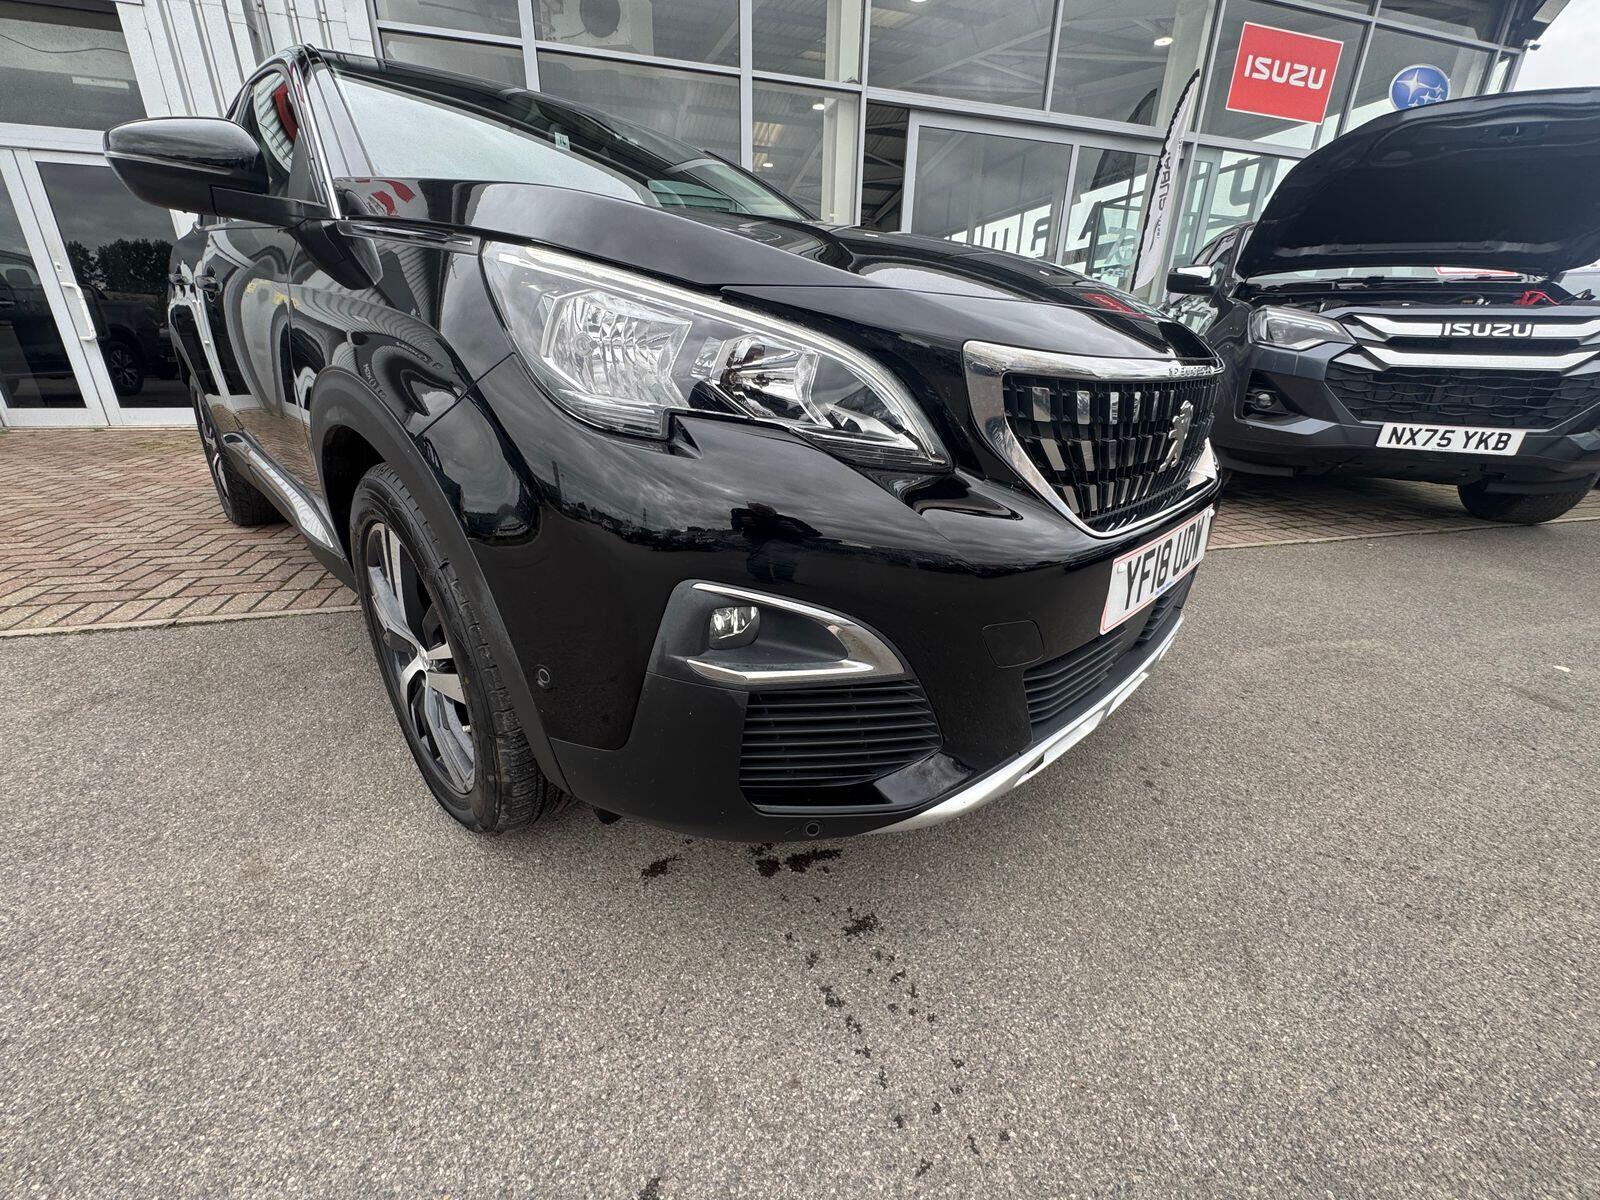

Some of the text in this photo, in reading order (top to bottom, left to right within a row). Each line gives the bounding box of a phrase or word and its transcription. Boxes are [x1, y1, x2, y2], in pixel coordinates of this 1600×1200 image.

[1244, 54, 1327, 90] ISUZU
[1443, 323, 1532, 337] ISUZU
[1387, 426, 1512, 451] NX75 YKB
[1125, 538, 1173, 611] YF18
